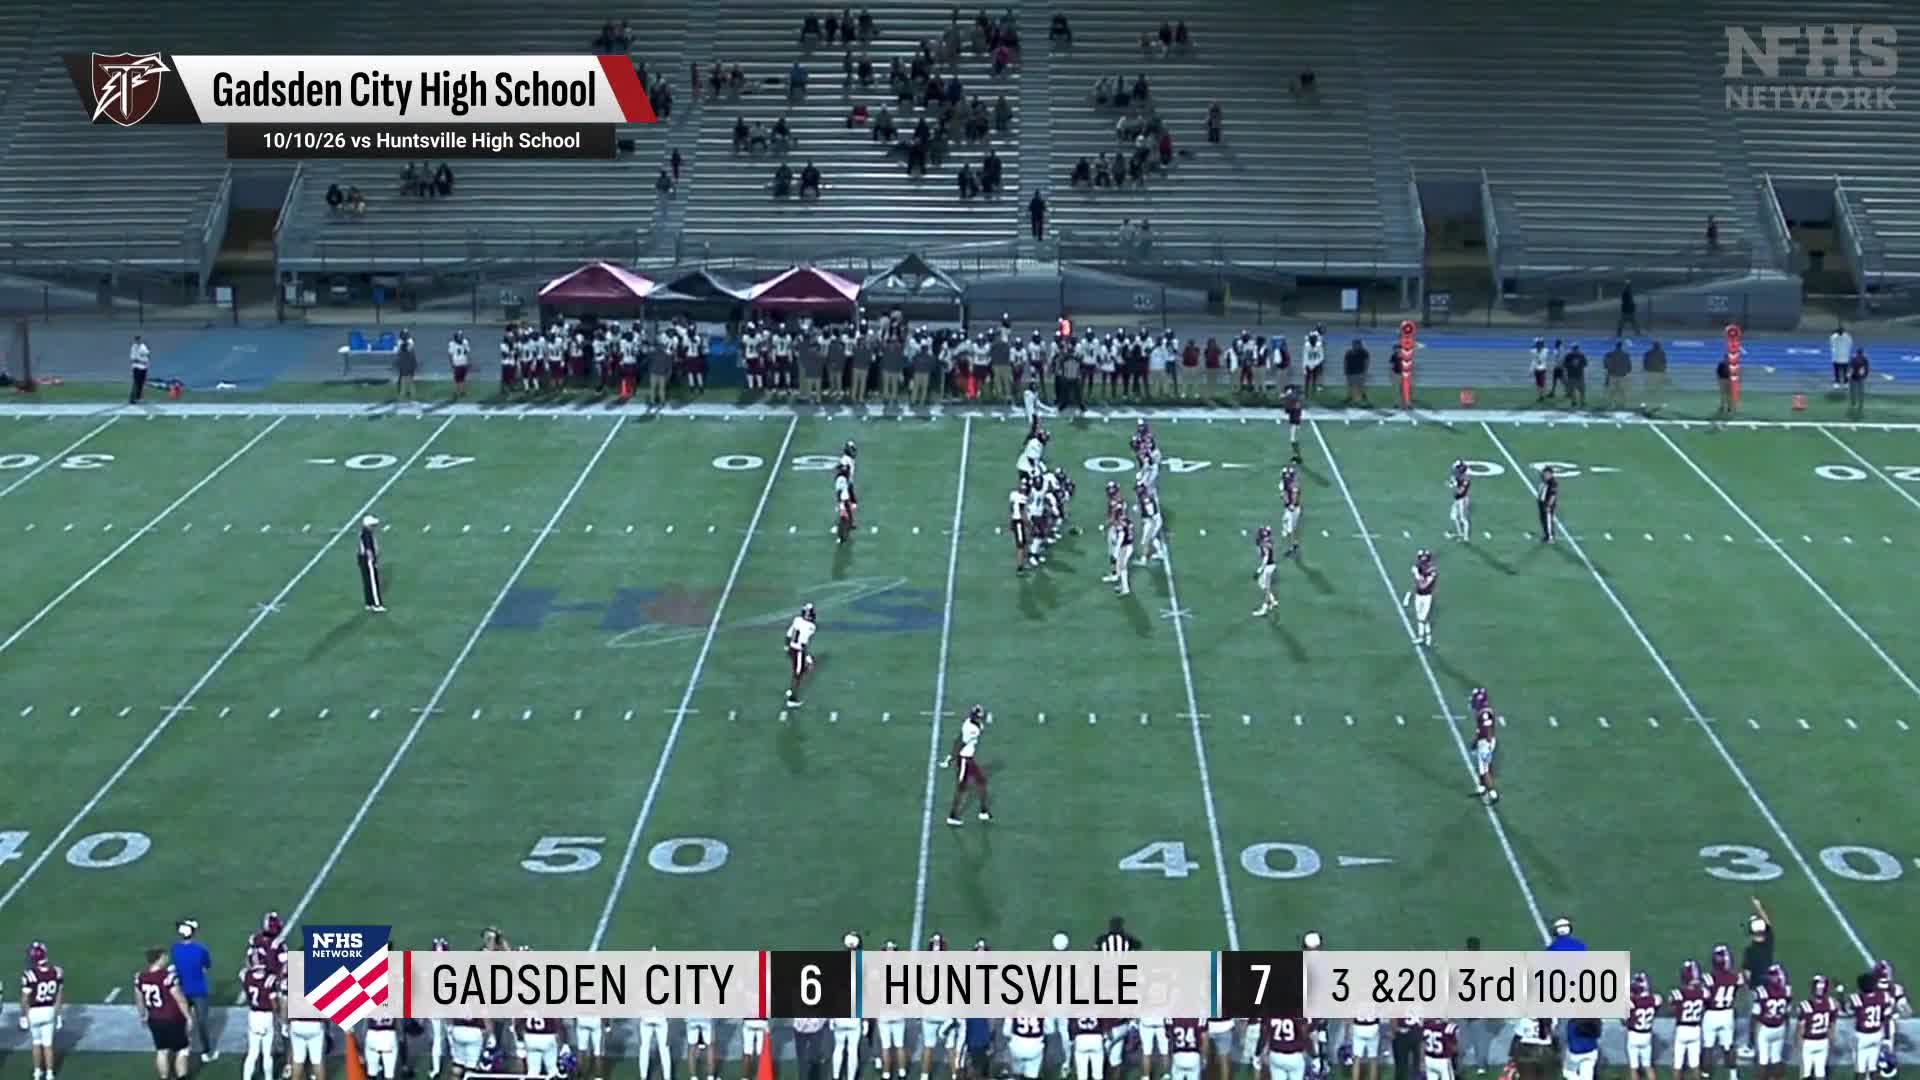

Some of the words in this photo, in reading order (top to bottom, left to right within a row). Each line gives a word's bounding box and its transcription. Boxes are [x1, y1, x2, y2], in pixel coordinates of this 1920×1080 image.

[520, 836, 729, 873] 50
[1118, 841, 1321, 878] 40
[1699, 844, 1904, 881] 30
[142, 984, 163, 1007] 73
[1714, 986, 1736, 1009] 44
[1682, 1000, 1704, 1023] 22
[1864, 1005, 1882, 1028] 31
[1270, 1018, 1296, 1042] 79
[1811, 1013, 1831, 1034] 21
[1175, 1027, 1196, 1048] 34
[1423, 1030, 1443, 1053] 35
